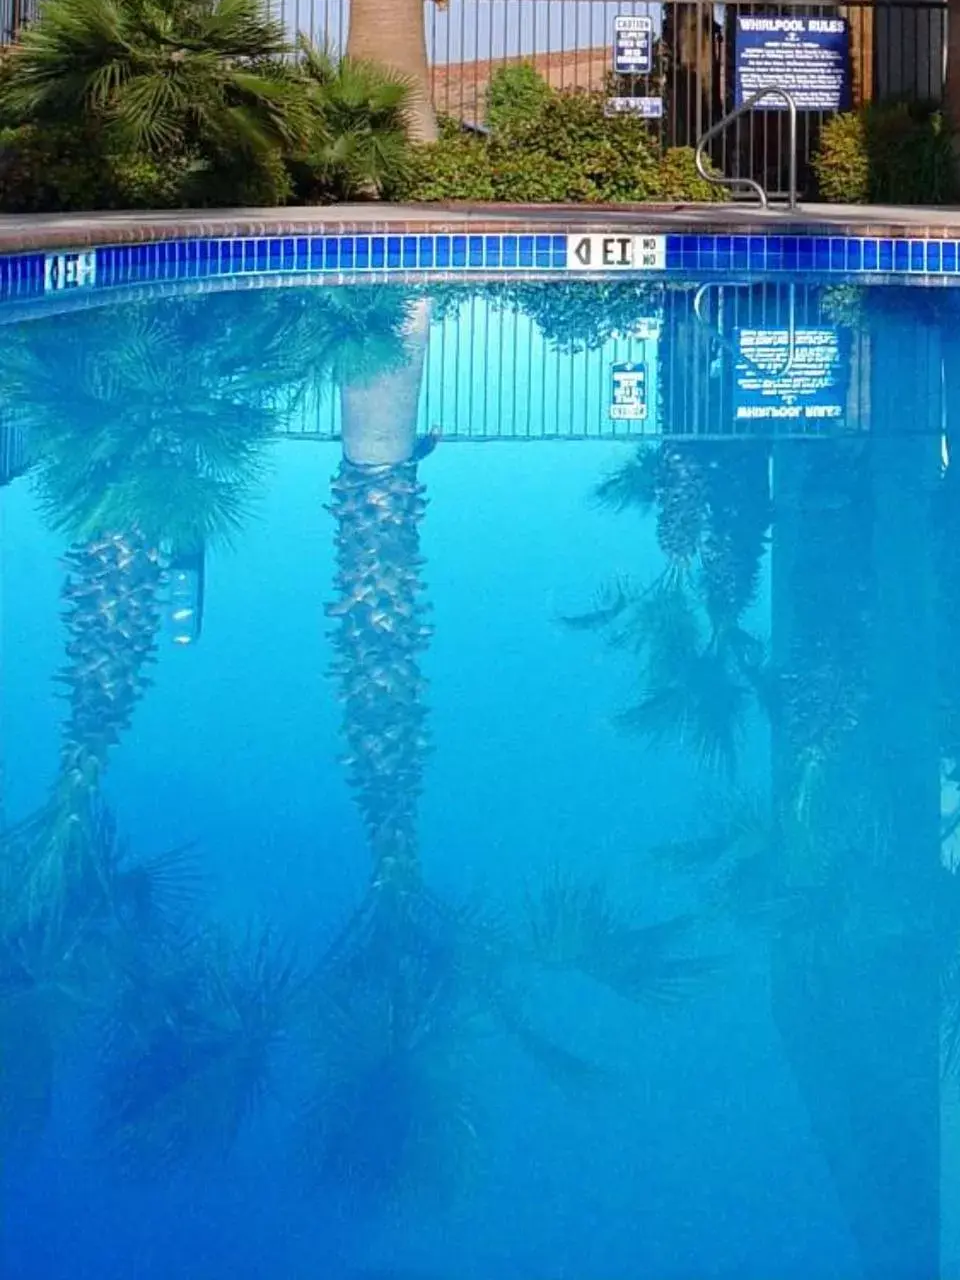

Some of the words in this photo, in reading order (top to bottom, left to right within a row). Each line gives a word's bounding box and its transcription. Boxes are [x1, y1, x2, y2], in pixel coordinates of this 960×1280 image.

[617, 20, 649, 29] CAUTION
[739, 18, 805, 32] WHIRLPOOL
[808, 20, 845, 33] RULES
